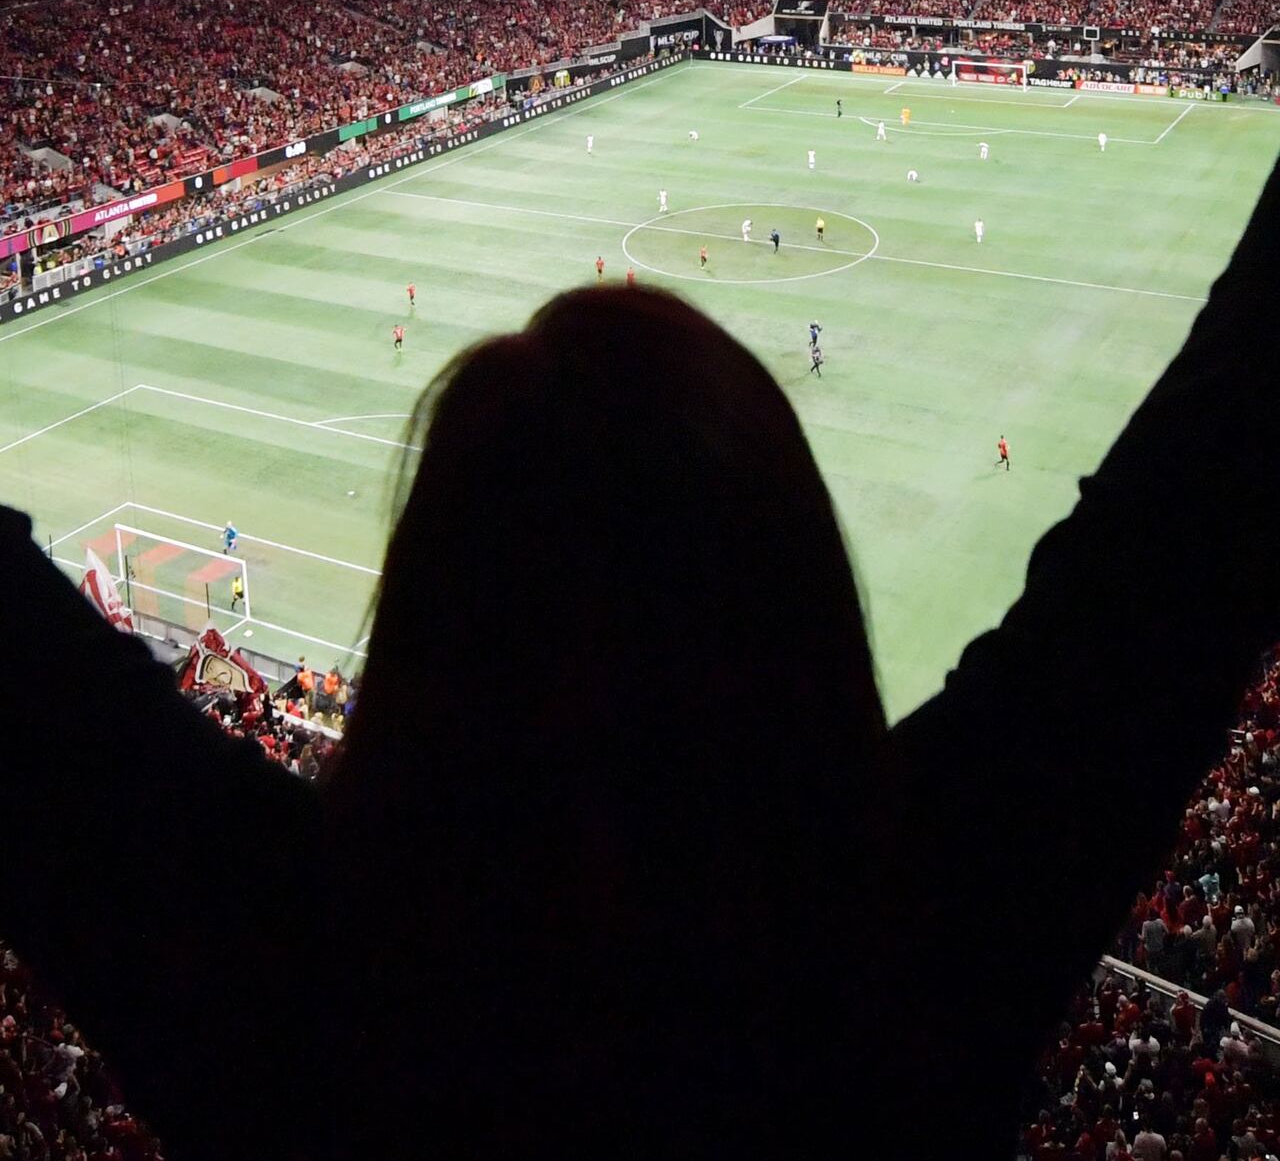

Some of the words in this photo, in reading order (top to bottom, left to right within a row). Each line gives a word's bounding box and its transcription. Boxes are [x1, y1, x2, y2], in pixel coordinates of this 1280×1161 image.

[884, 16, 916, 25] ATLANTA
[953, 20, 992, 29] PORTLAND
[710, 52, 731, 61] ONE
[738, 55, 768, 64] GAME
[776, 57, 789, 65] TO
[797, 59, 835, 69] GLORY
[429, 144, 442, 155] TO
[94, 203, 129, 222] ATLANTA
[196, 226, 222, 244] ONE
[231, 210, 267, 231] GAME
[275, 201, 290, 214] TO
[298, 184, 336, 206] GLORY
[14, 288, 61, 313] GAME
[72, 276, 91, 291] TO
[103, 252, 153, 279] GLORY
